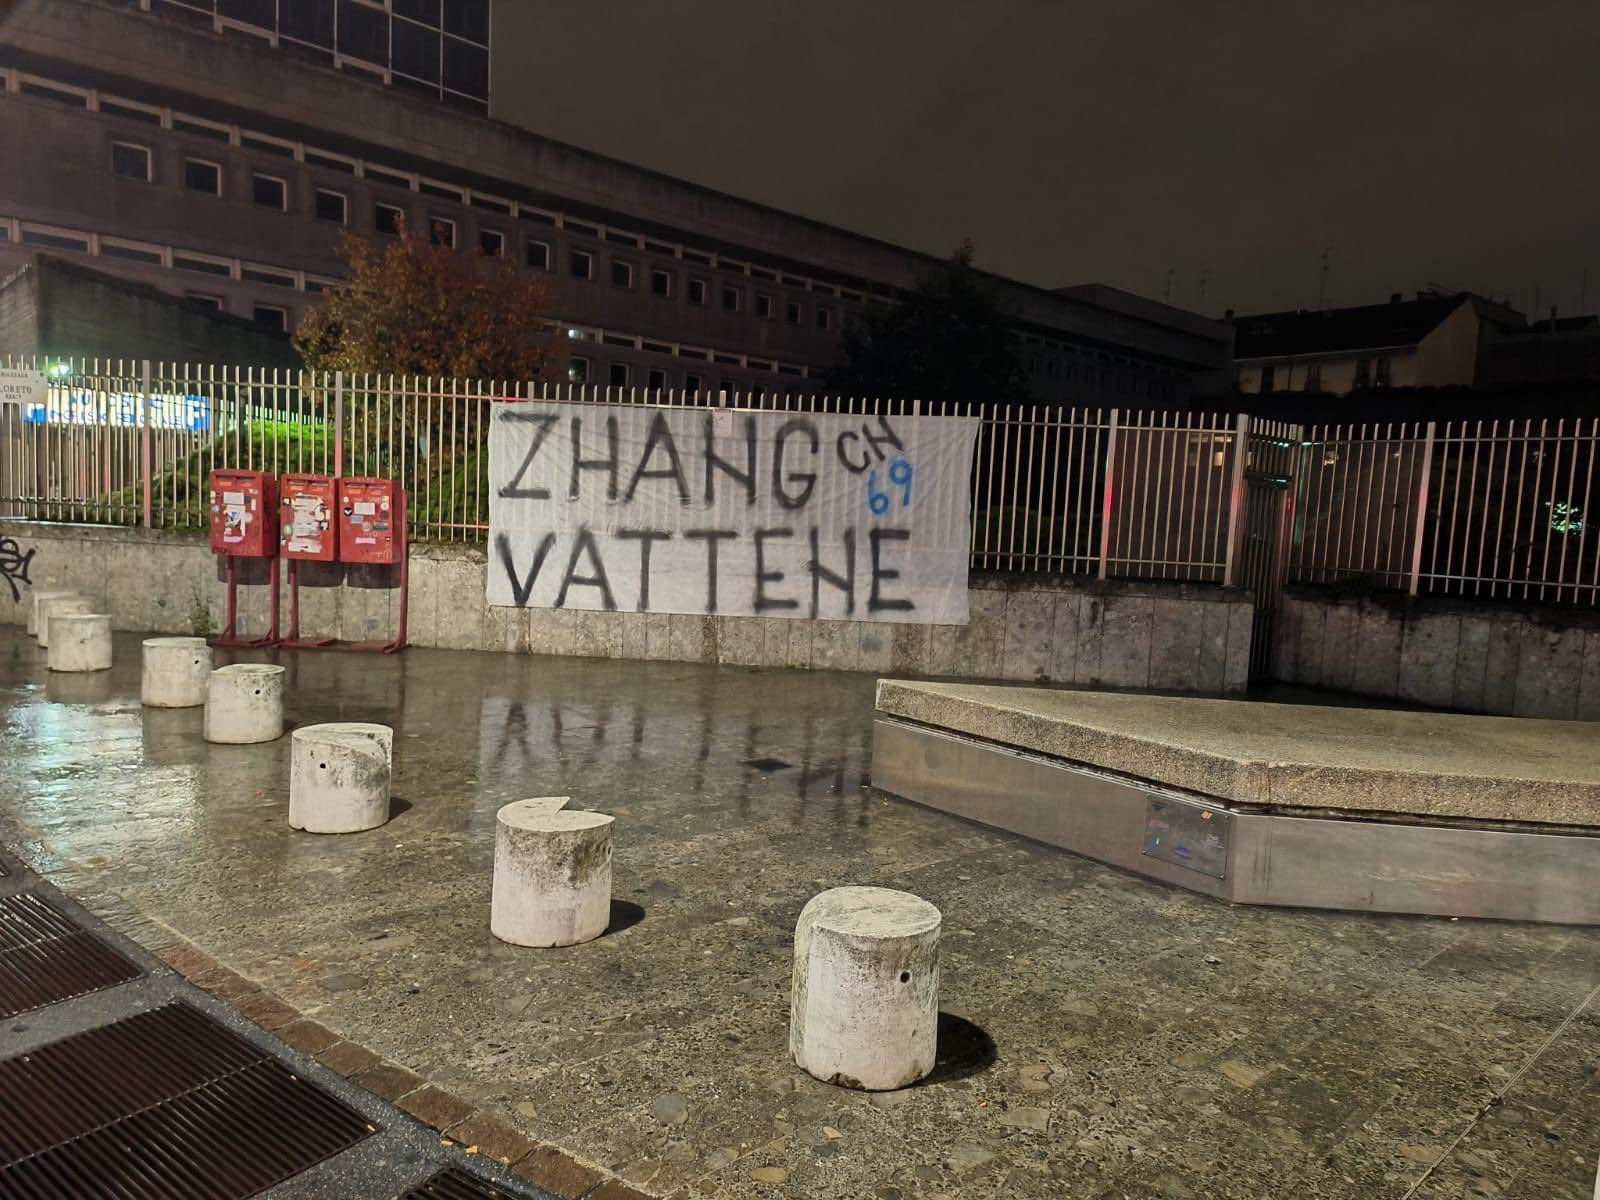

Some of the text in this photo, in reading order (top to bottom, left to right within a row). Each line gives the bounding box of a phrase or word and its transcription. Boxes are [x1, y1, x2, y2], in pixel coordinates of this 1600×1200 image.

[498, 410, 820, 509] ZHANG
[866, 456, 914, 516] 69
[496, 525, 916, 619] VATTENE
